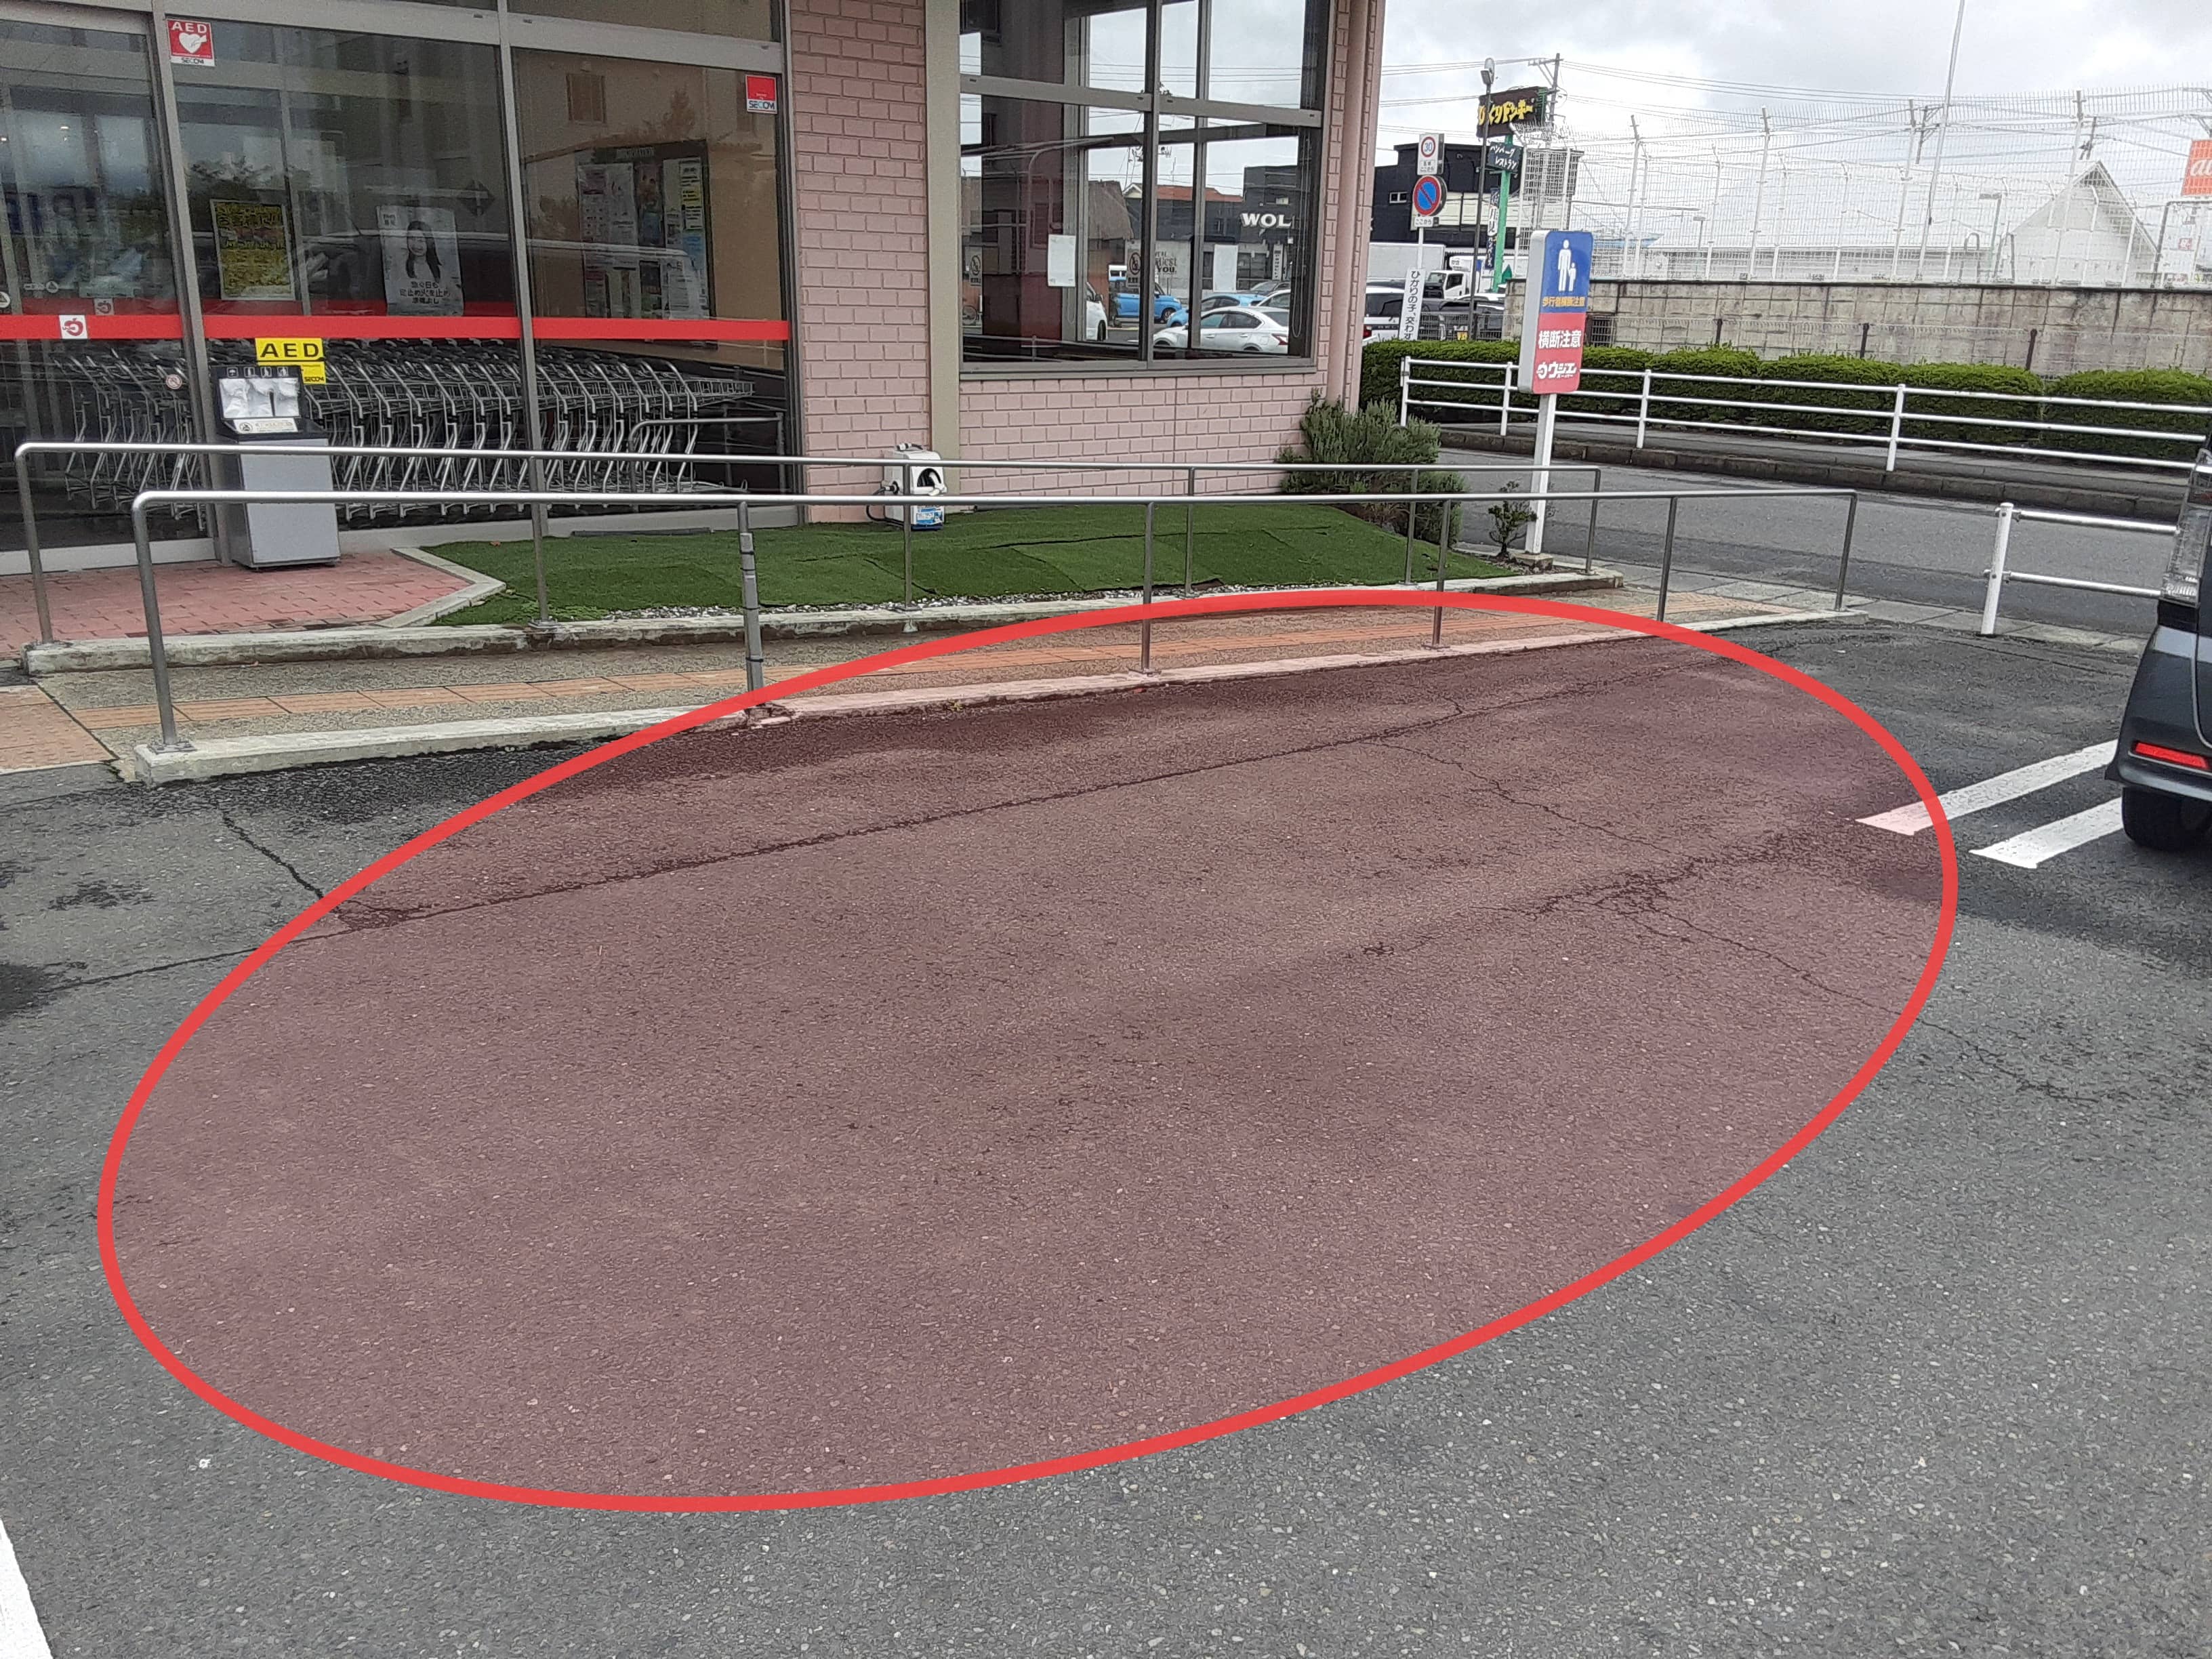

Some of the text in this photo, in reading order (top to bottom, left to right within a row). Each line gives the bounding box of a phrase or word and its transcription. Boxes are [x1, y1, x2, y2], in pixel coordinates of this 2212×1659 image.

[171, 21, 207, 34] AED
[749, 100, 775, 110] SECOM
[1425, 142, 1433, 152] 30
[1495, 157, 1517, 169] レストラン
[1538, 329, 1582, 349] 横断注意
[260, 342, 319, 358] AED
